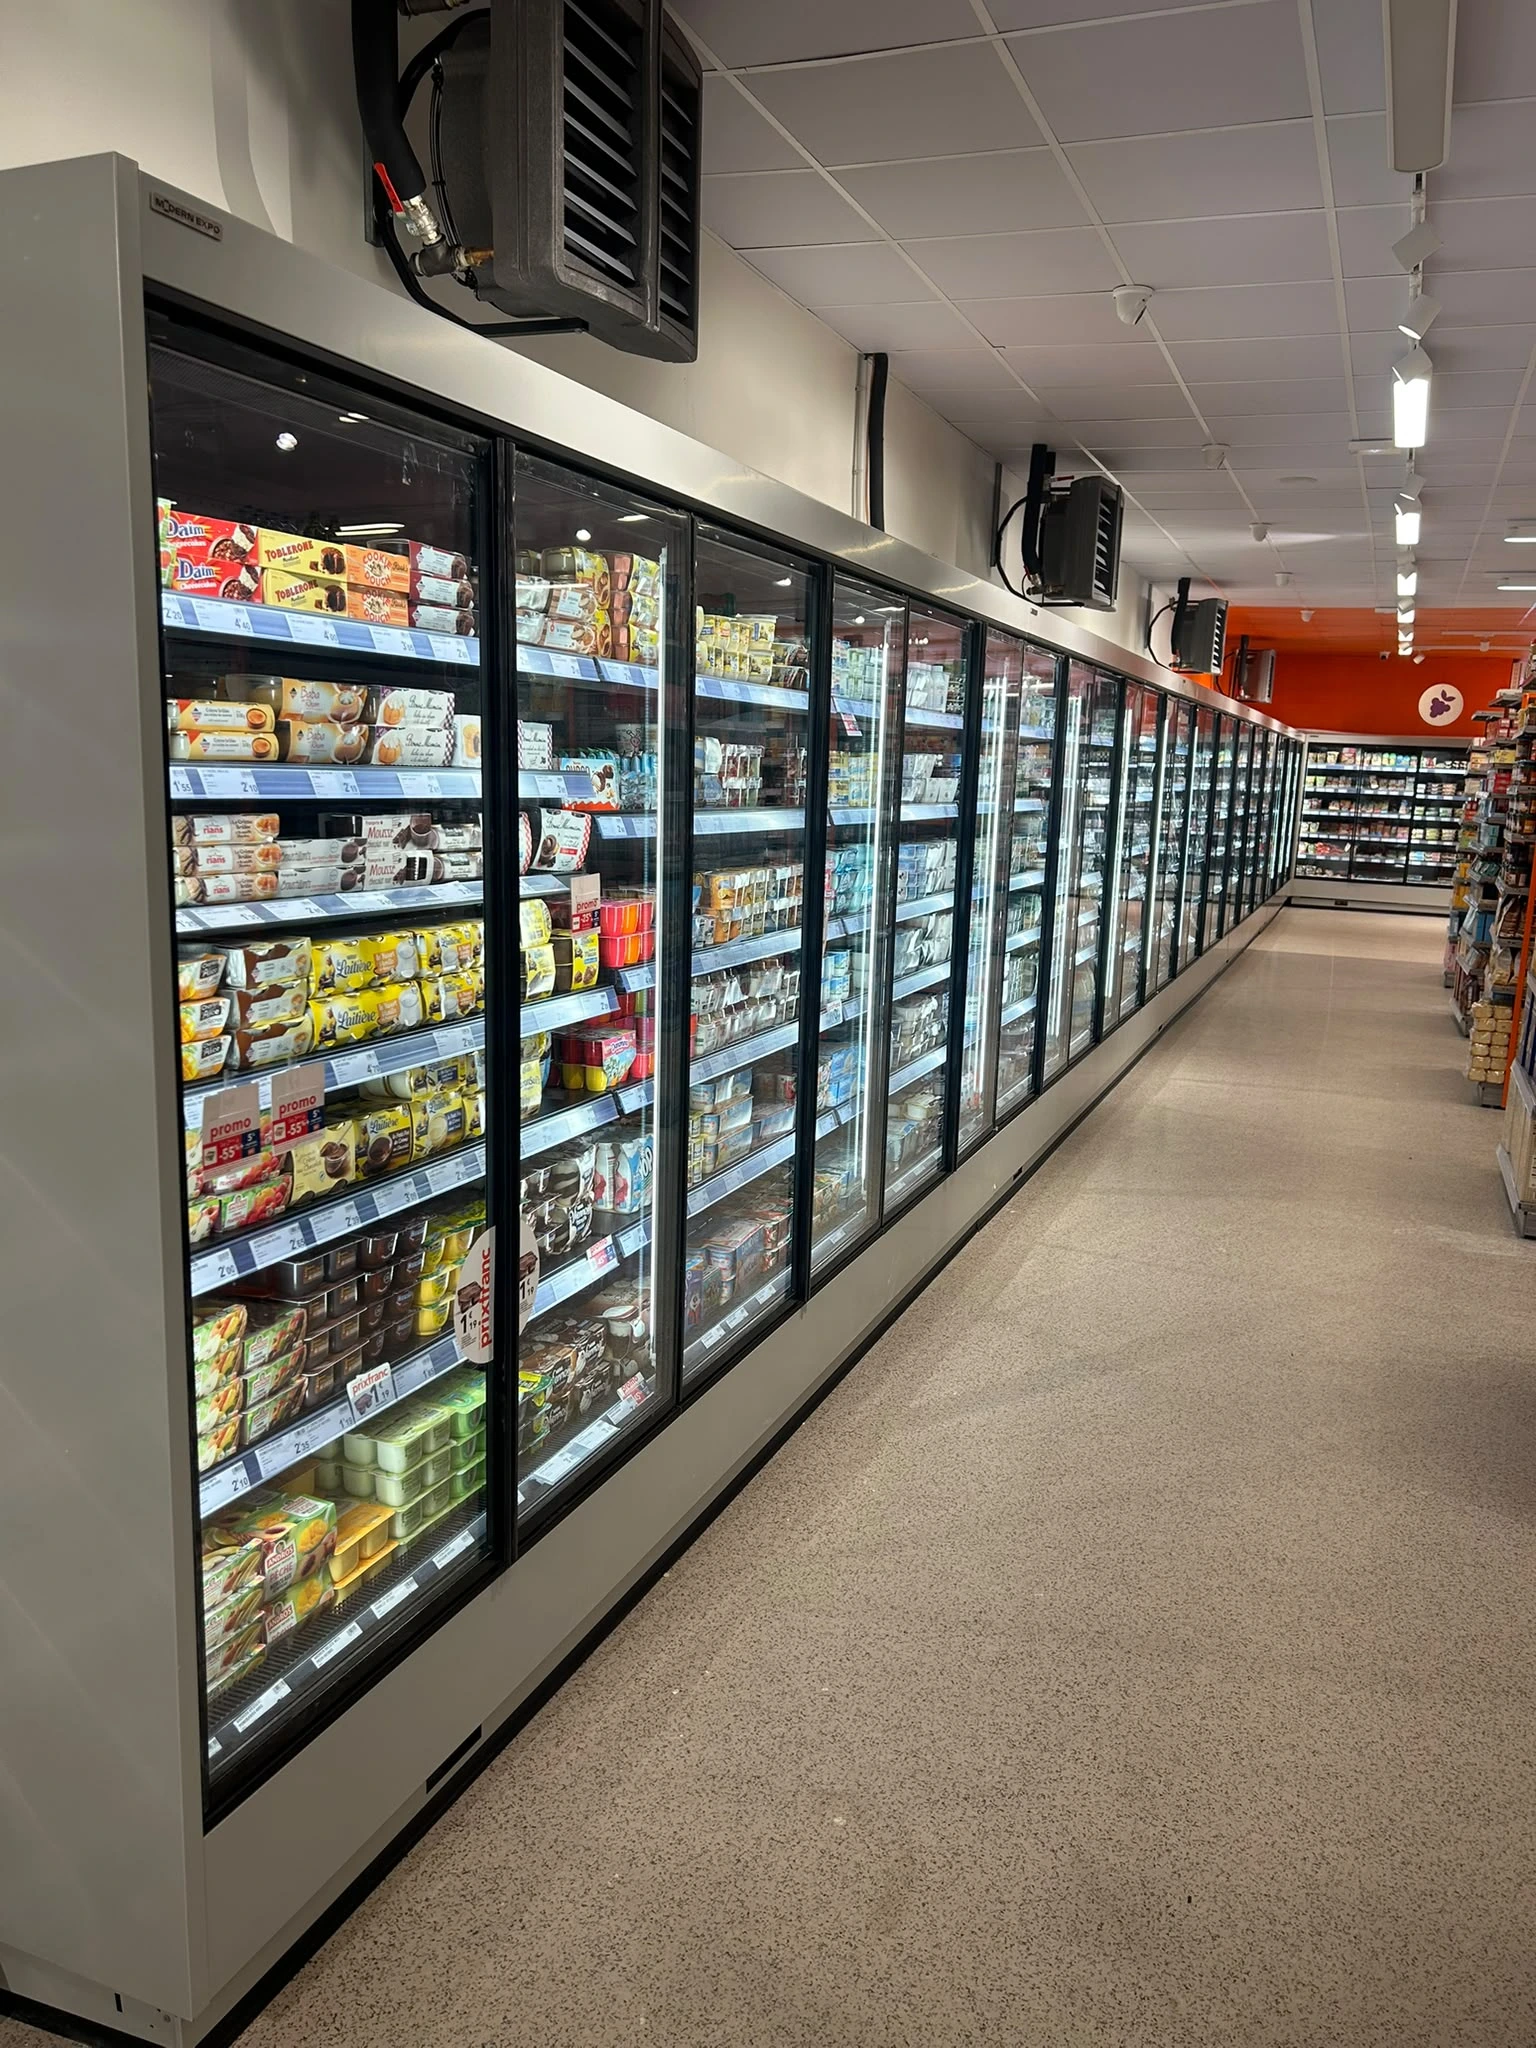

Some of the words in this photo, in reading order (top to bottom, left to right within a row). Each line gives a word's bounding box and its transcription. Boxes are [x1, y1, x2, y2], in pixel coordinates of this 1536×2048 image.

[155, 197, 194, 222] MODERN
[196, 217, 220, 234] EXPO
[167, 518, 204, 538] Daim
[264, 540, 314, 562] TOBLERONE
[362, 551, 392, 569] COOKIE
[179, 559, 215, 580] Daim
[364, 571, 392, 587] DOUGH
[275, 579, 319, 602] TOBLERONE
[368, 826, 394, 839] Mousse
[369, 864, 396, 877] Mousse
[213, 887, 230, 895] rians
[338, 1010, 377, 1030] Laitière
[279, 1095, 317, 1120] promo
[210, 1117, 252, 1141] promo
[478, 1247, 492, 1349] prixfranc
[352, 1368, 389, 1396] prixfranc
[267, 1544, 295, 1567] ANDROS
[267, 1606, 292, 1629] ANDROS
